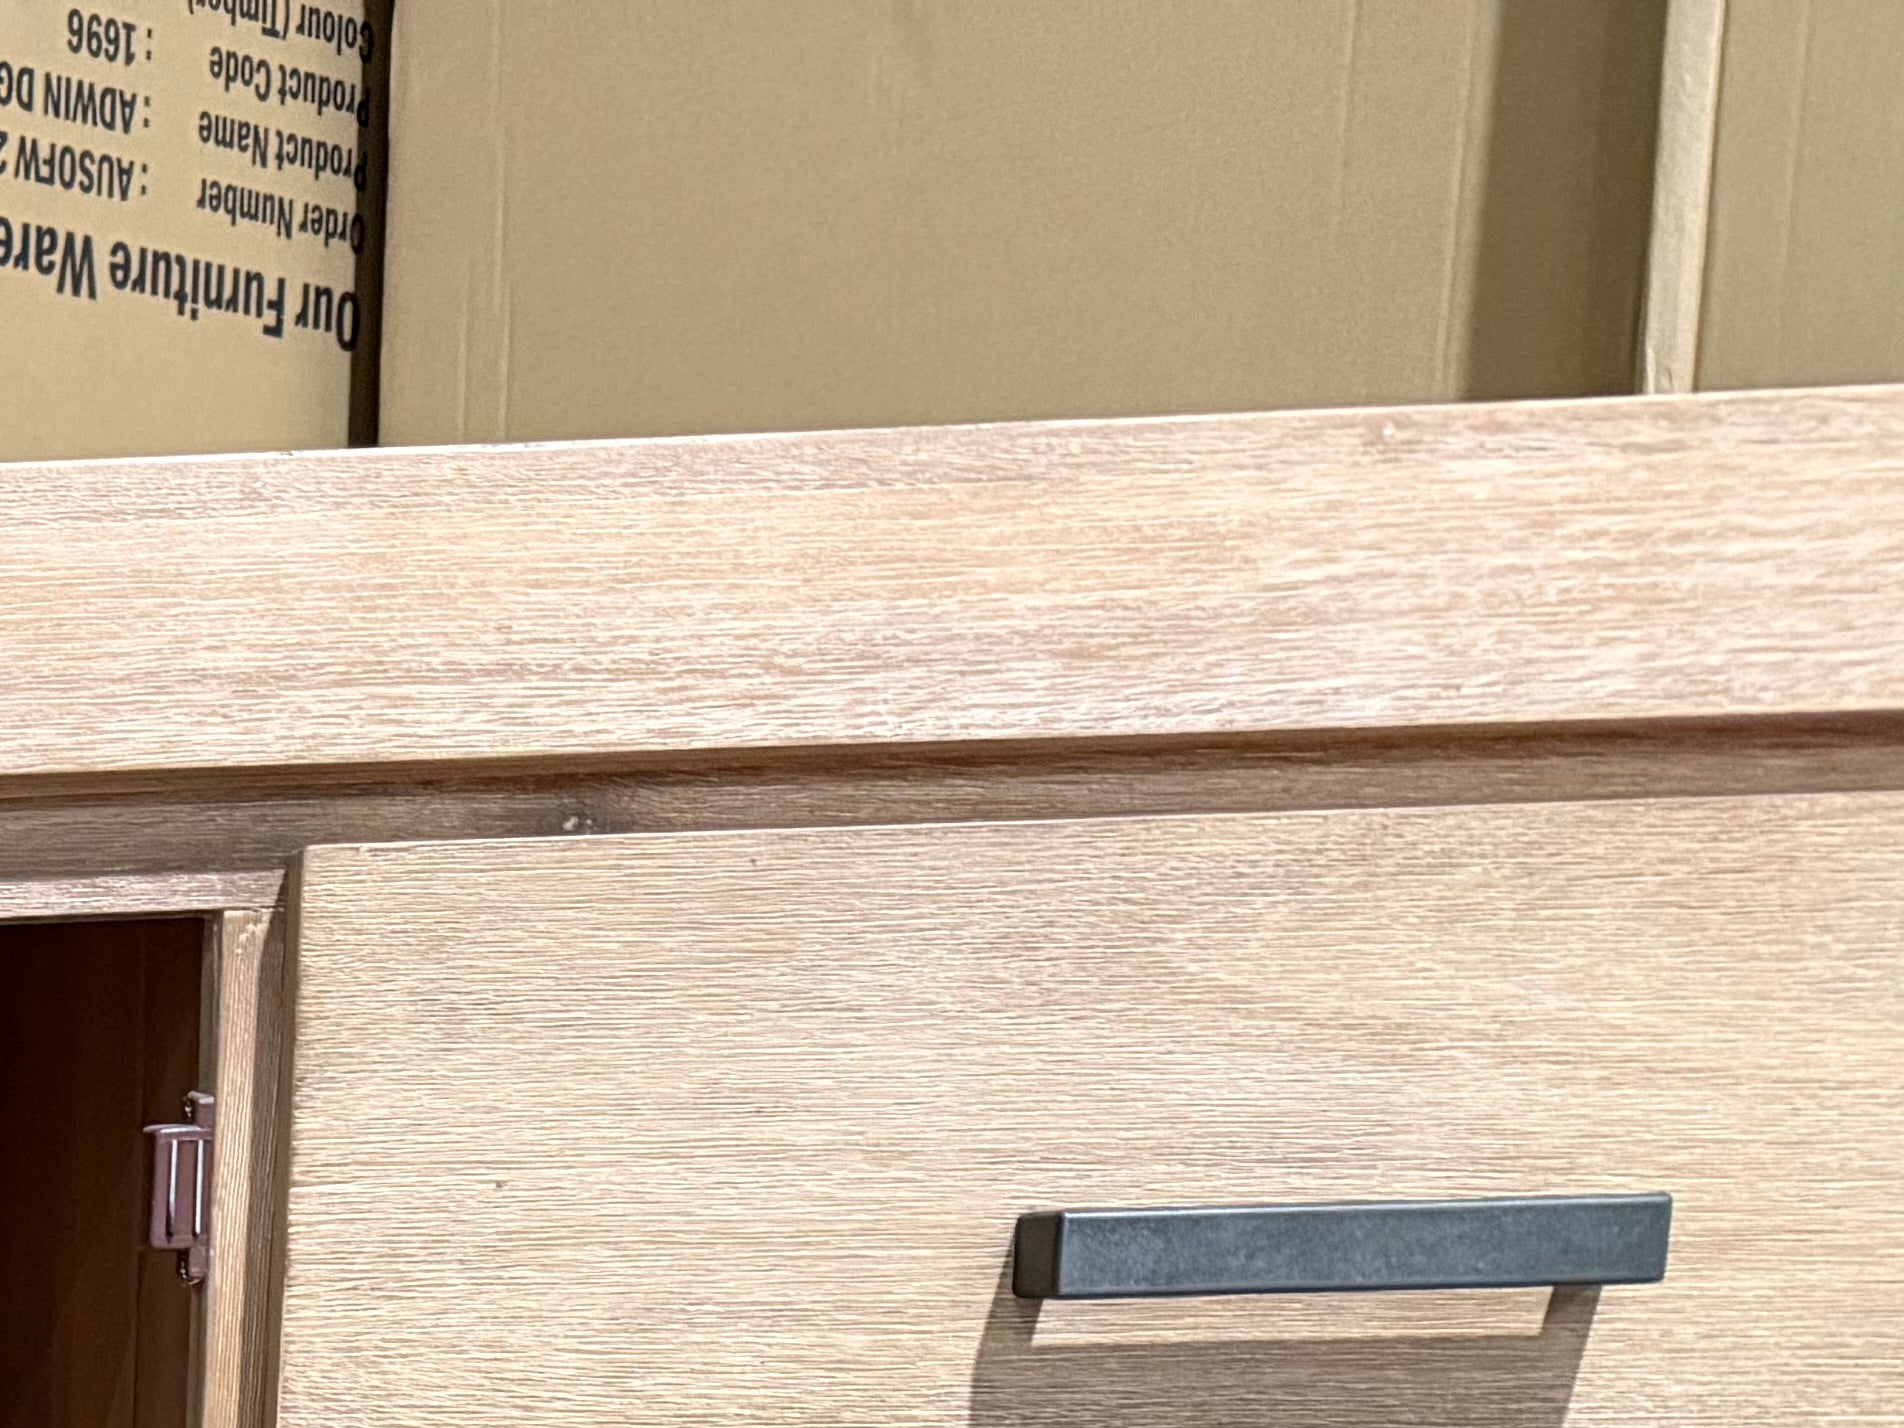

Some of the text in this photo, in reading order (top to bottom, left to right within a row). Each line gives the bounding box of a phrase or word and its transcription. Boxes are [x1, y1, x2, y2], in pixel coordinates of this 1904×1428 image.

[67, 8, 137, 67] 1696
[295, 3, 374, 64] Colour
[44, 71, 137, 135] ADWIN
[209, 46, 272, 102] Code
[277, 63, 370, 128] Product
[14, 135, 135, 202] AUSOFW
[198, 110, 269, 169] Name
[275, 129, 367, 192] Product
[196, 178, 294, 240] Number
[299, 202, 365, 256] Order
[109, 240, 286, 339] Furniture
[294, 282, 360, 352] Our
